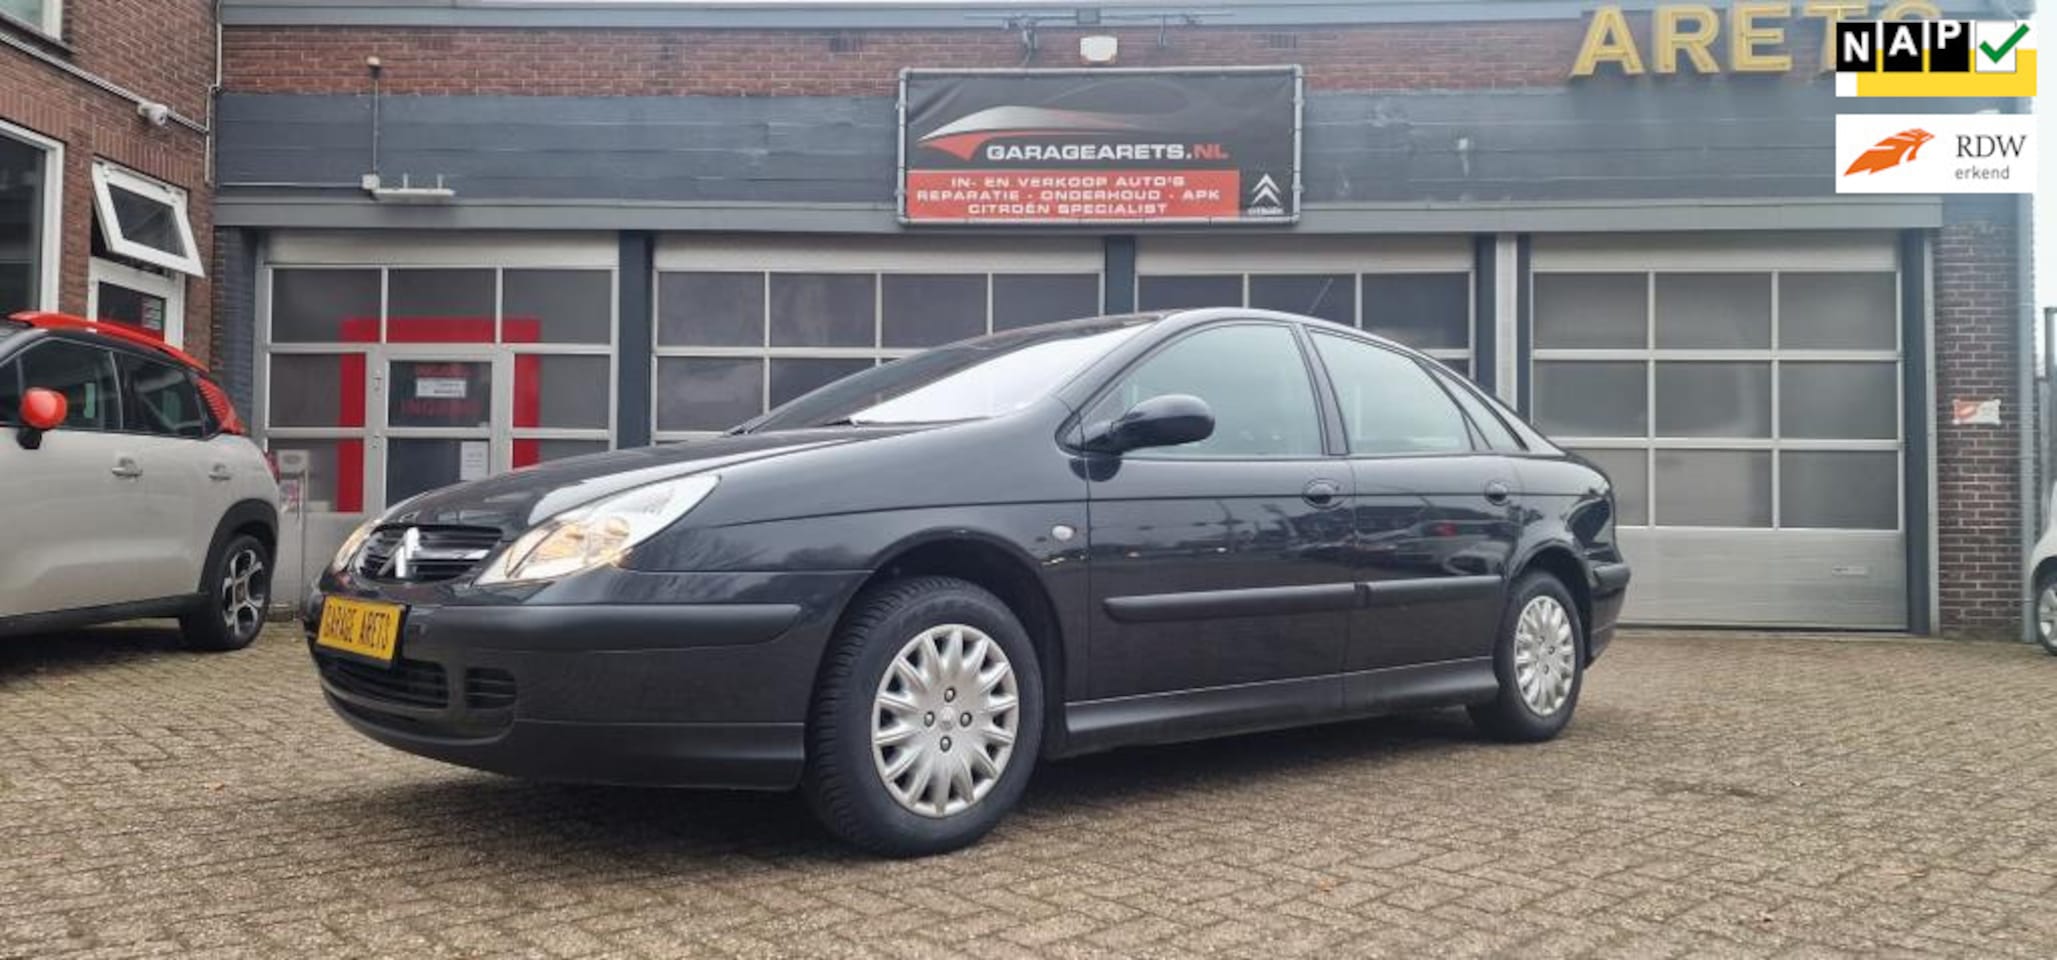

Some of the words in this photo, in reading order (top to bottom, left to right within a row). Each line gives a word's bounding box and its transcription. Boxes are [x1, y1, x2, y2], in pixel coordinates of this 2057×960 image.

[1570, 0, 1944, 77] ARET
[986, 144, 1230, 161] GARAGEARETS.NL
[951, 177, 977, 187] IN-
[984, 177, 1009, 187] EN
[1018, 176, 1108, 187] VERKOOP
[1116, 175, 1186, 187] AUTO'S
[917, 190, 1019, 201] REPARATIE
[1041, 189, 1160, 201] ONDERHOUD
[1182, 189, 1220, 201] APK
[1057, 203, 1168, 214] SPECIALIST
[323, 604, 357, 643] GARAGE
[360, 609, 391, 650] ARETS
